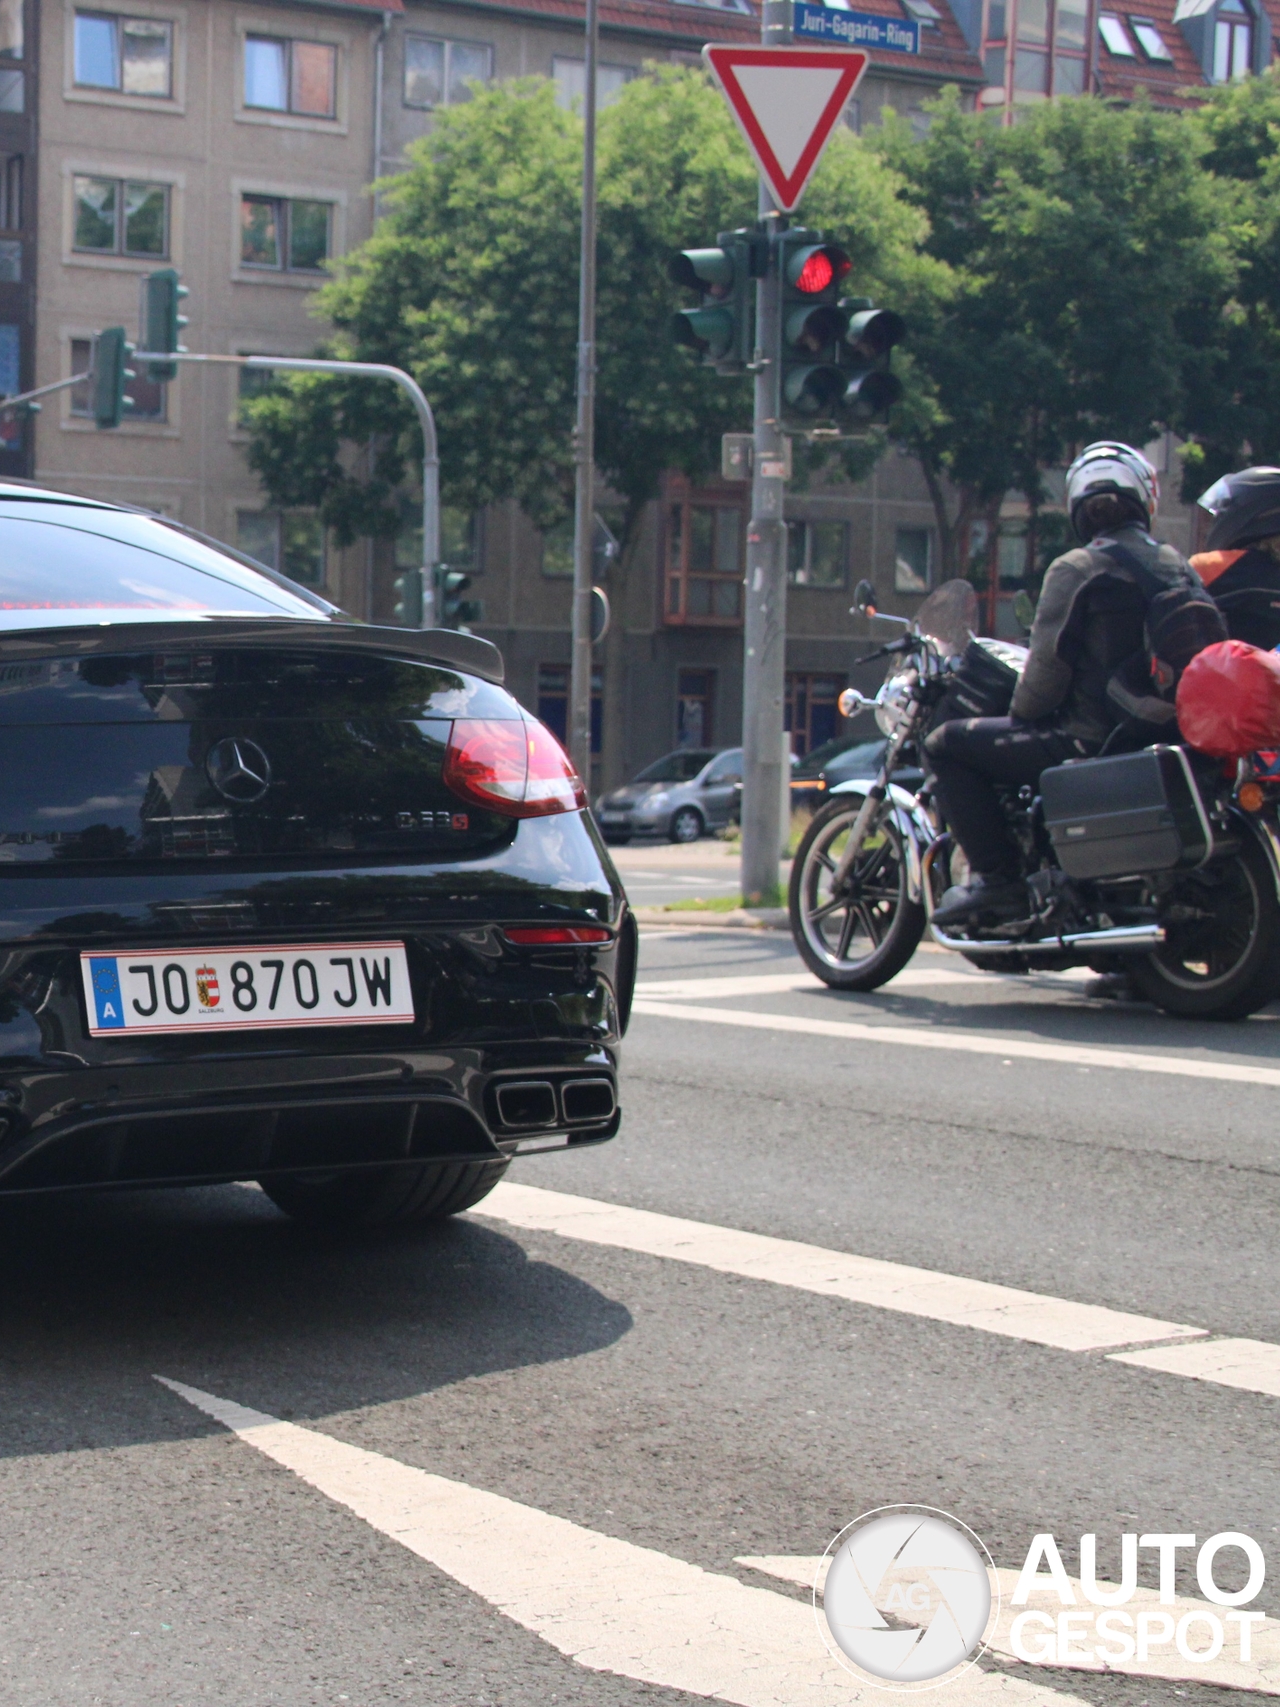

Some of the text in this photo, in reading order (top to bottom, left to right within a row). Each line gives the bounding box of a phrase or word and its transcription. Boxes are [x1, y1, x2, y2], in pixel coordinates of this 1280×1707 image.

[801, 9, 914, 52] Juri-Gagarin-Ring
[103, 1002, 116, 1018] A
[128, 963, 190, 1016] JO
